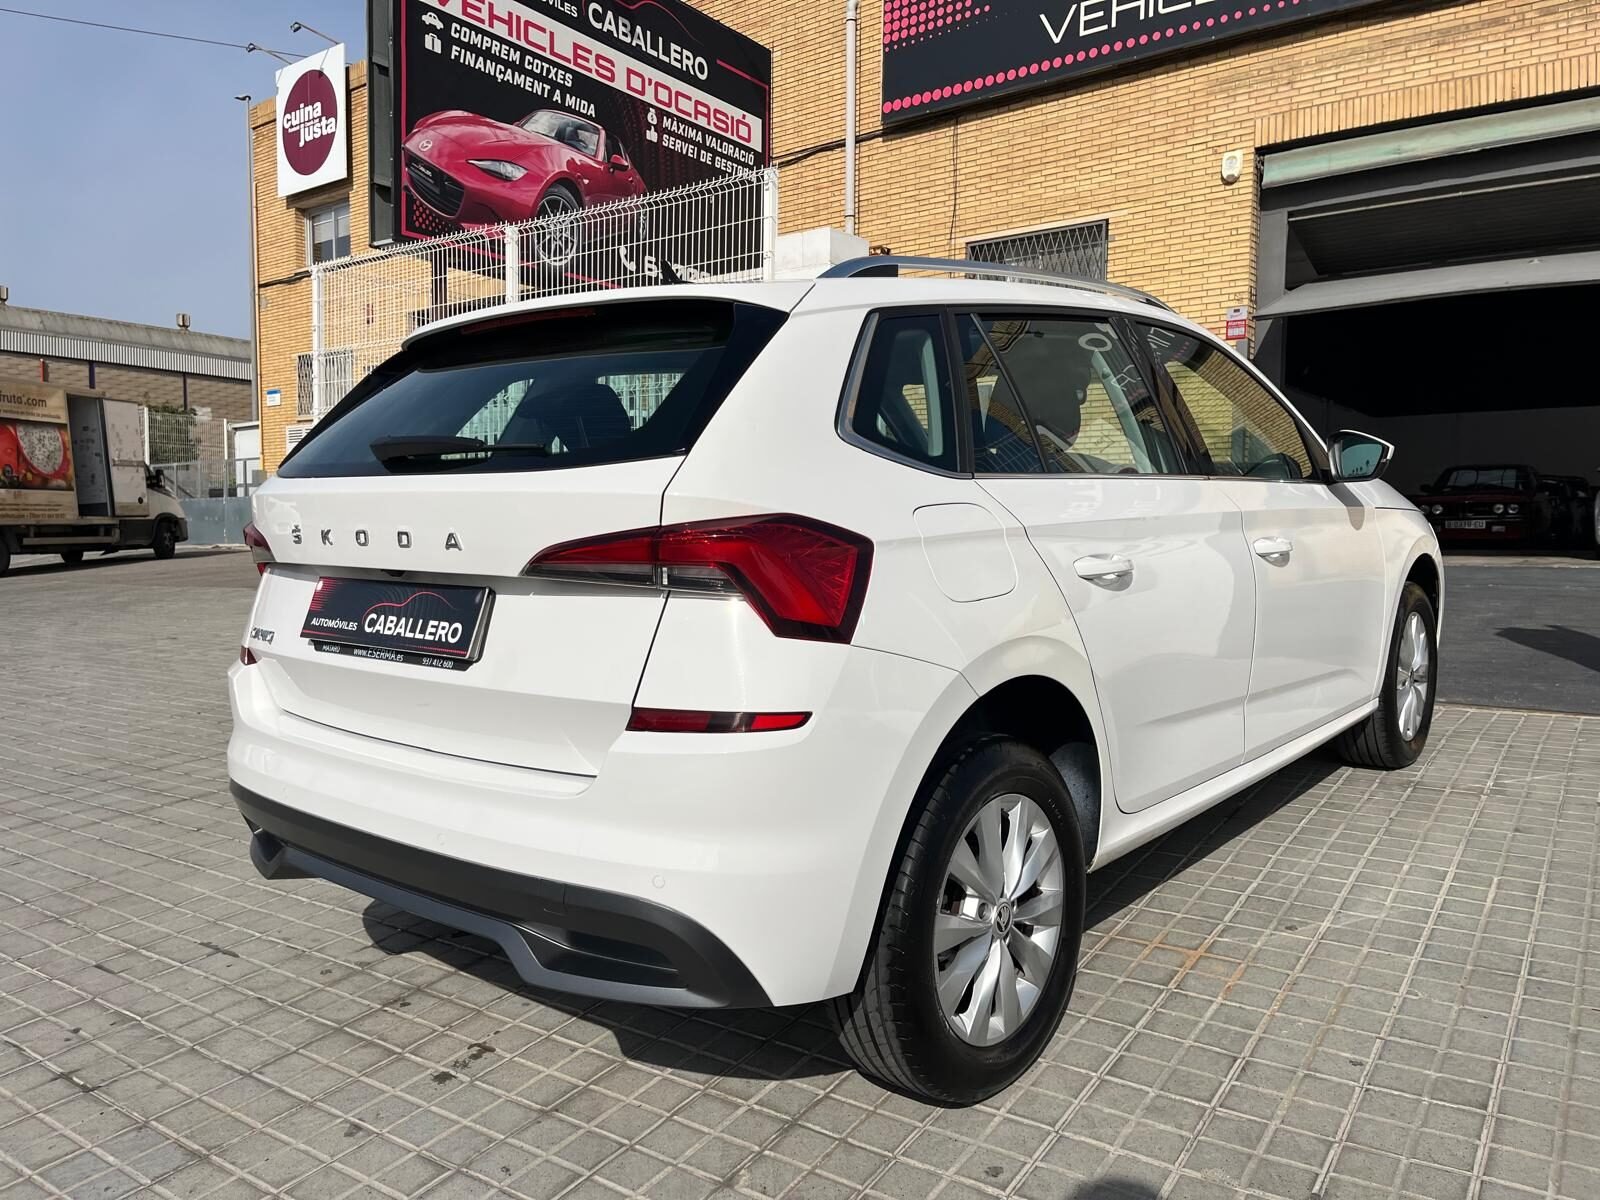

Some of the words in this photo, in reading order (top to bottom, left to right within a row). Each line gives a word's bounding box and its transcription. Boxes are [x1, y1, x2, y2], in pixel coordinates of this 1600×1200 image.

[588, 2, 709, 81] CABALLERO
[1039, 0, 1215, 44] VEHI
[450, 22, 520, 65] COMPREM
[524, 54, 574, 88] COTXES
[450, 45, 551, 98] FINANÇAMENT
[552, 89, 562, 104] A
[564, 93, 597, 118] MIDA
[283, 101, 322, 129] cuina
[626, 66, 752, 144] D'OCASIÓ
[298, 115, 336, 148] justa
[662, 115, 703, 144] MÀXIMA
[705, 133, 755, 166] VALORACIÓ
[662, 133, 698, 160] SERVEI
[700, 149, 713, 165] DE
[291, 524, 463, 551] ŠKODA
[310, 617, 359, 632] AUTOMÓVILES
[363, 613, 463, 644] CABALLERO
